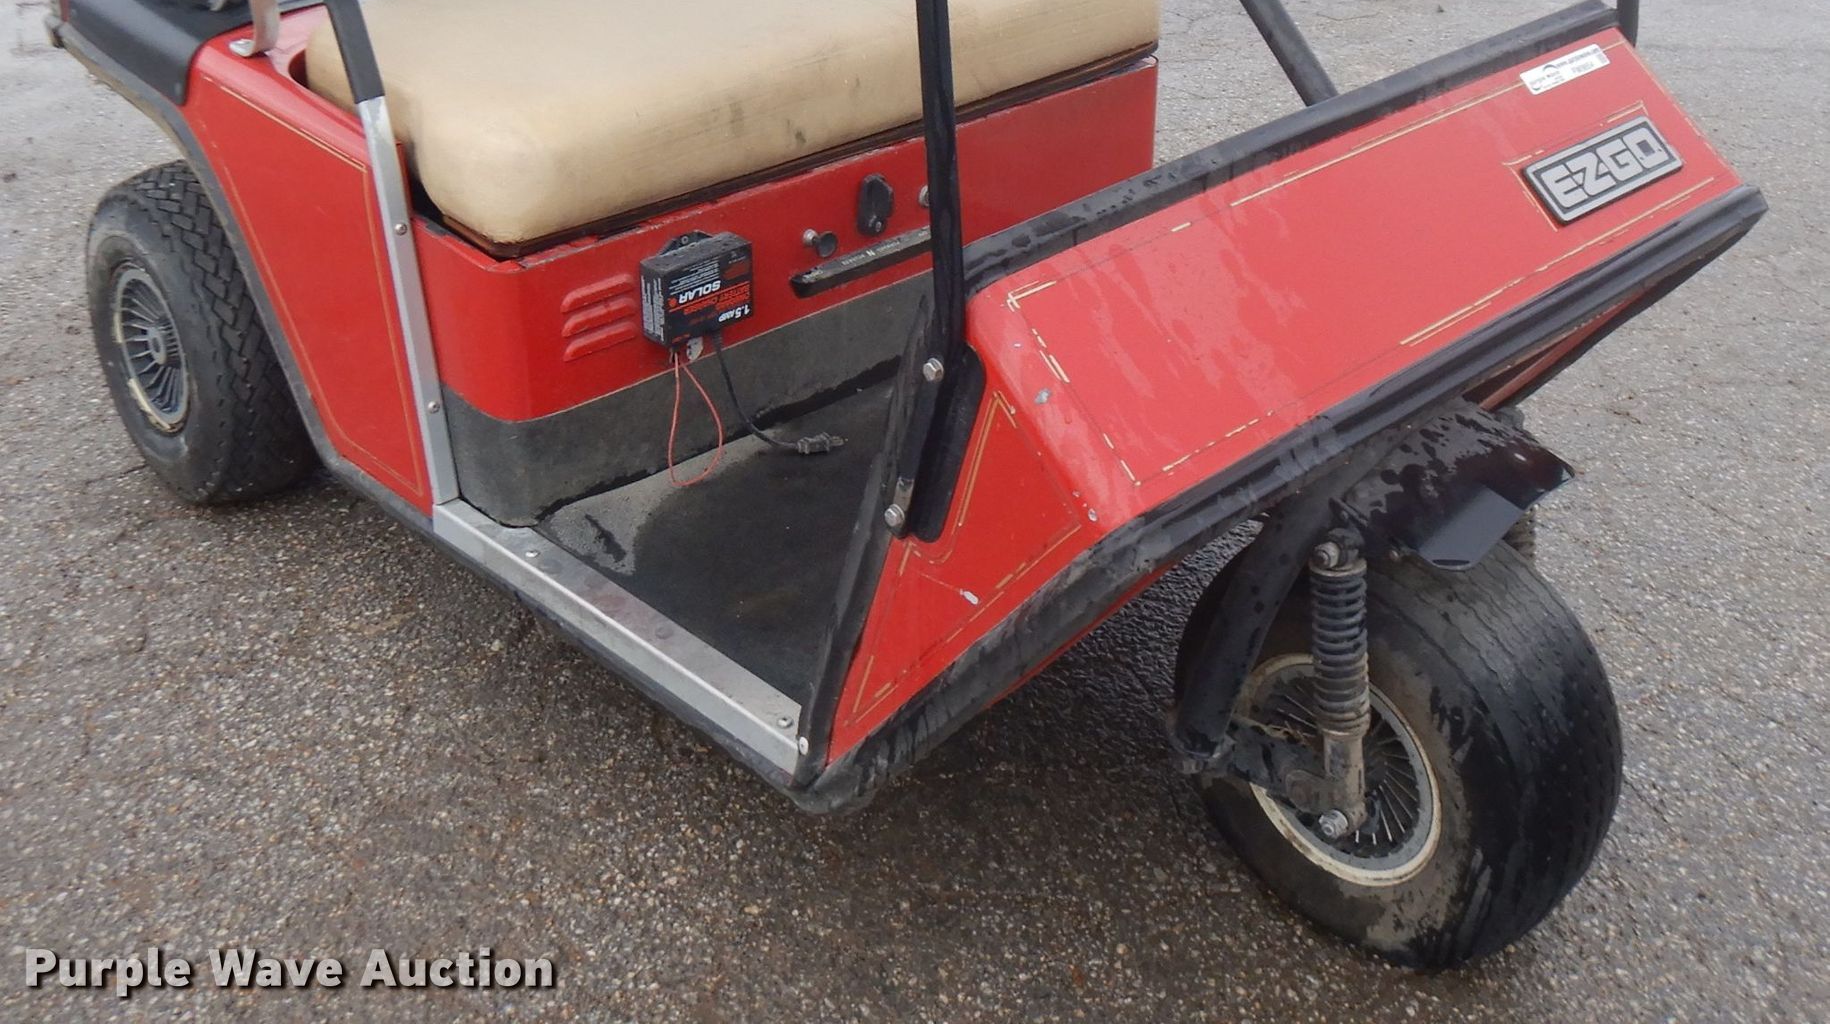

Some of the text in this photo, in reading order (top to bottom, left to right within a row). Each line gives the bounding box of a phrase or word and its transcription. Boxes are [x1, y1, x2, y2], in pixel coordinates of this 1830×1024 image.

[1540, 126, 1670, 208] EZGO
[678, 280, 721, 304] SOLAR
[735, 304, 751, 319] 1.5
